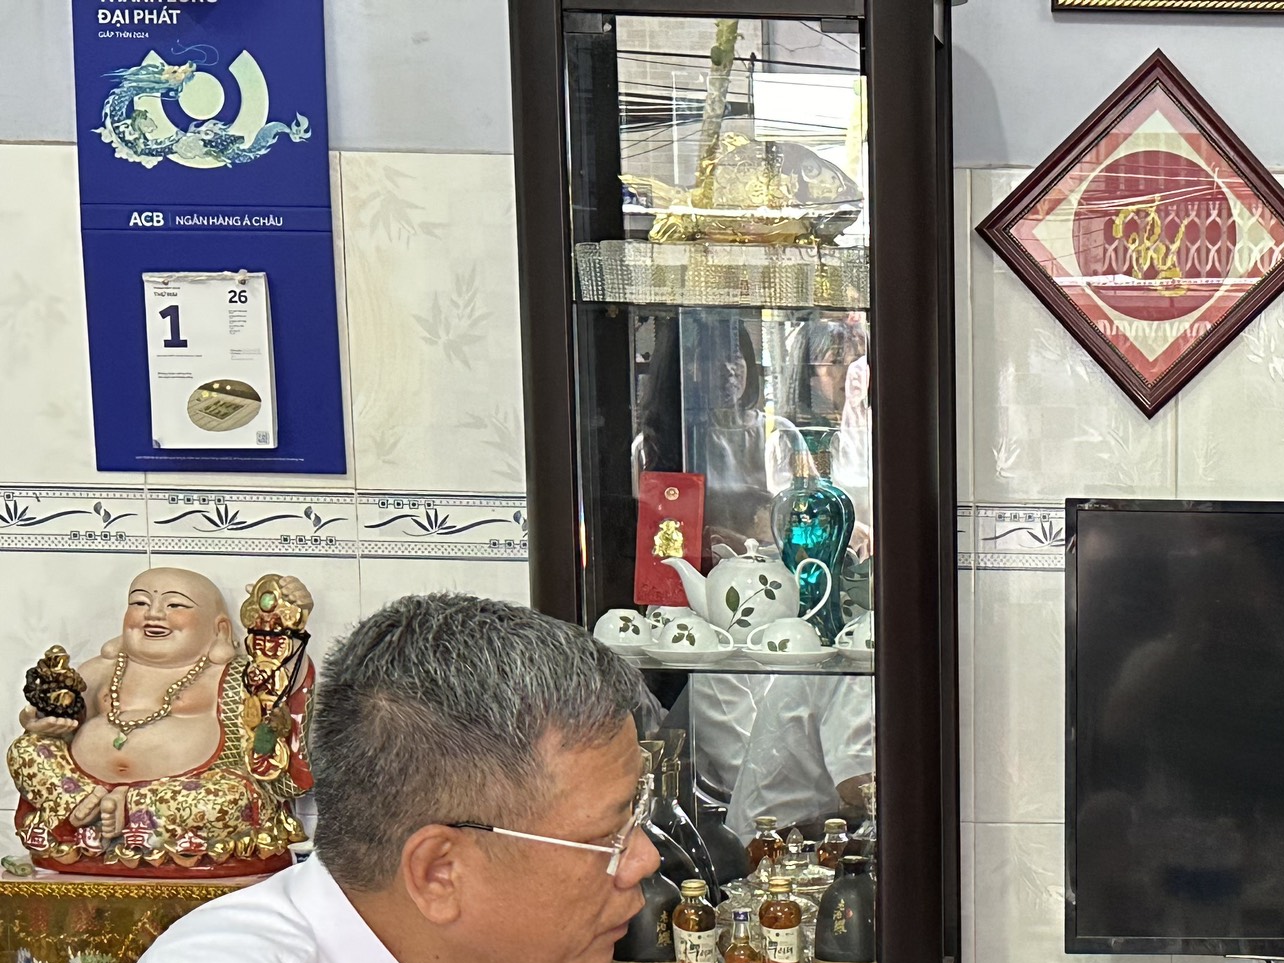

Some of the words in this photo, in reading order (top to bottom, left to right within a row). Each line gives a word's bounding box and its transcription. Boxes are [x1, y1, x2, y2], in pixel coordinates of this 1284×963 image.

[97, 9, 130, 27] ĐẠI
[133, 5, 181, 24] PHÁT
[129, 211, 165, 227] ACB
[175, 213, 208, 226] NGÂN
[209, 214, 241, 226] HÀNG
[242, 213, 251, 226] Á
[252, 214, 283, 226] CHÂU
[228, 289, 248, 304] 26
[158, 304, 188, 348] 1
